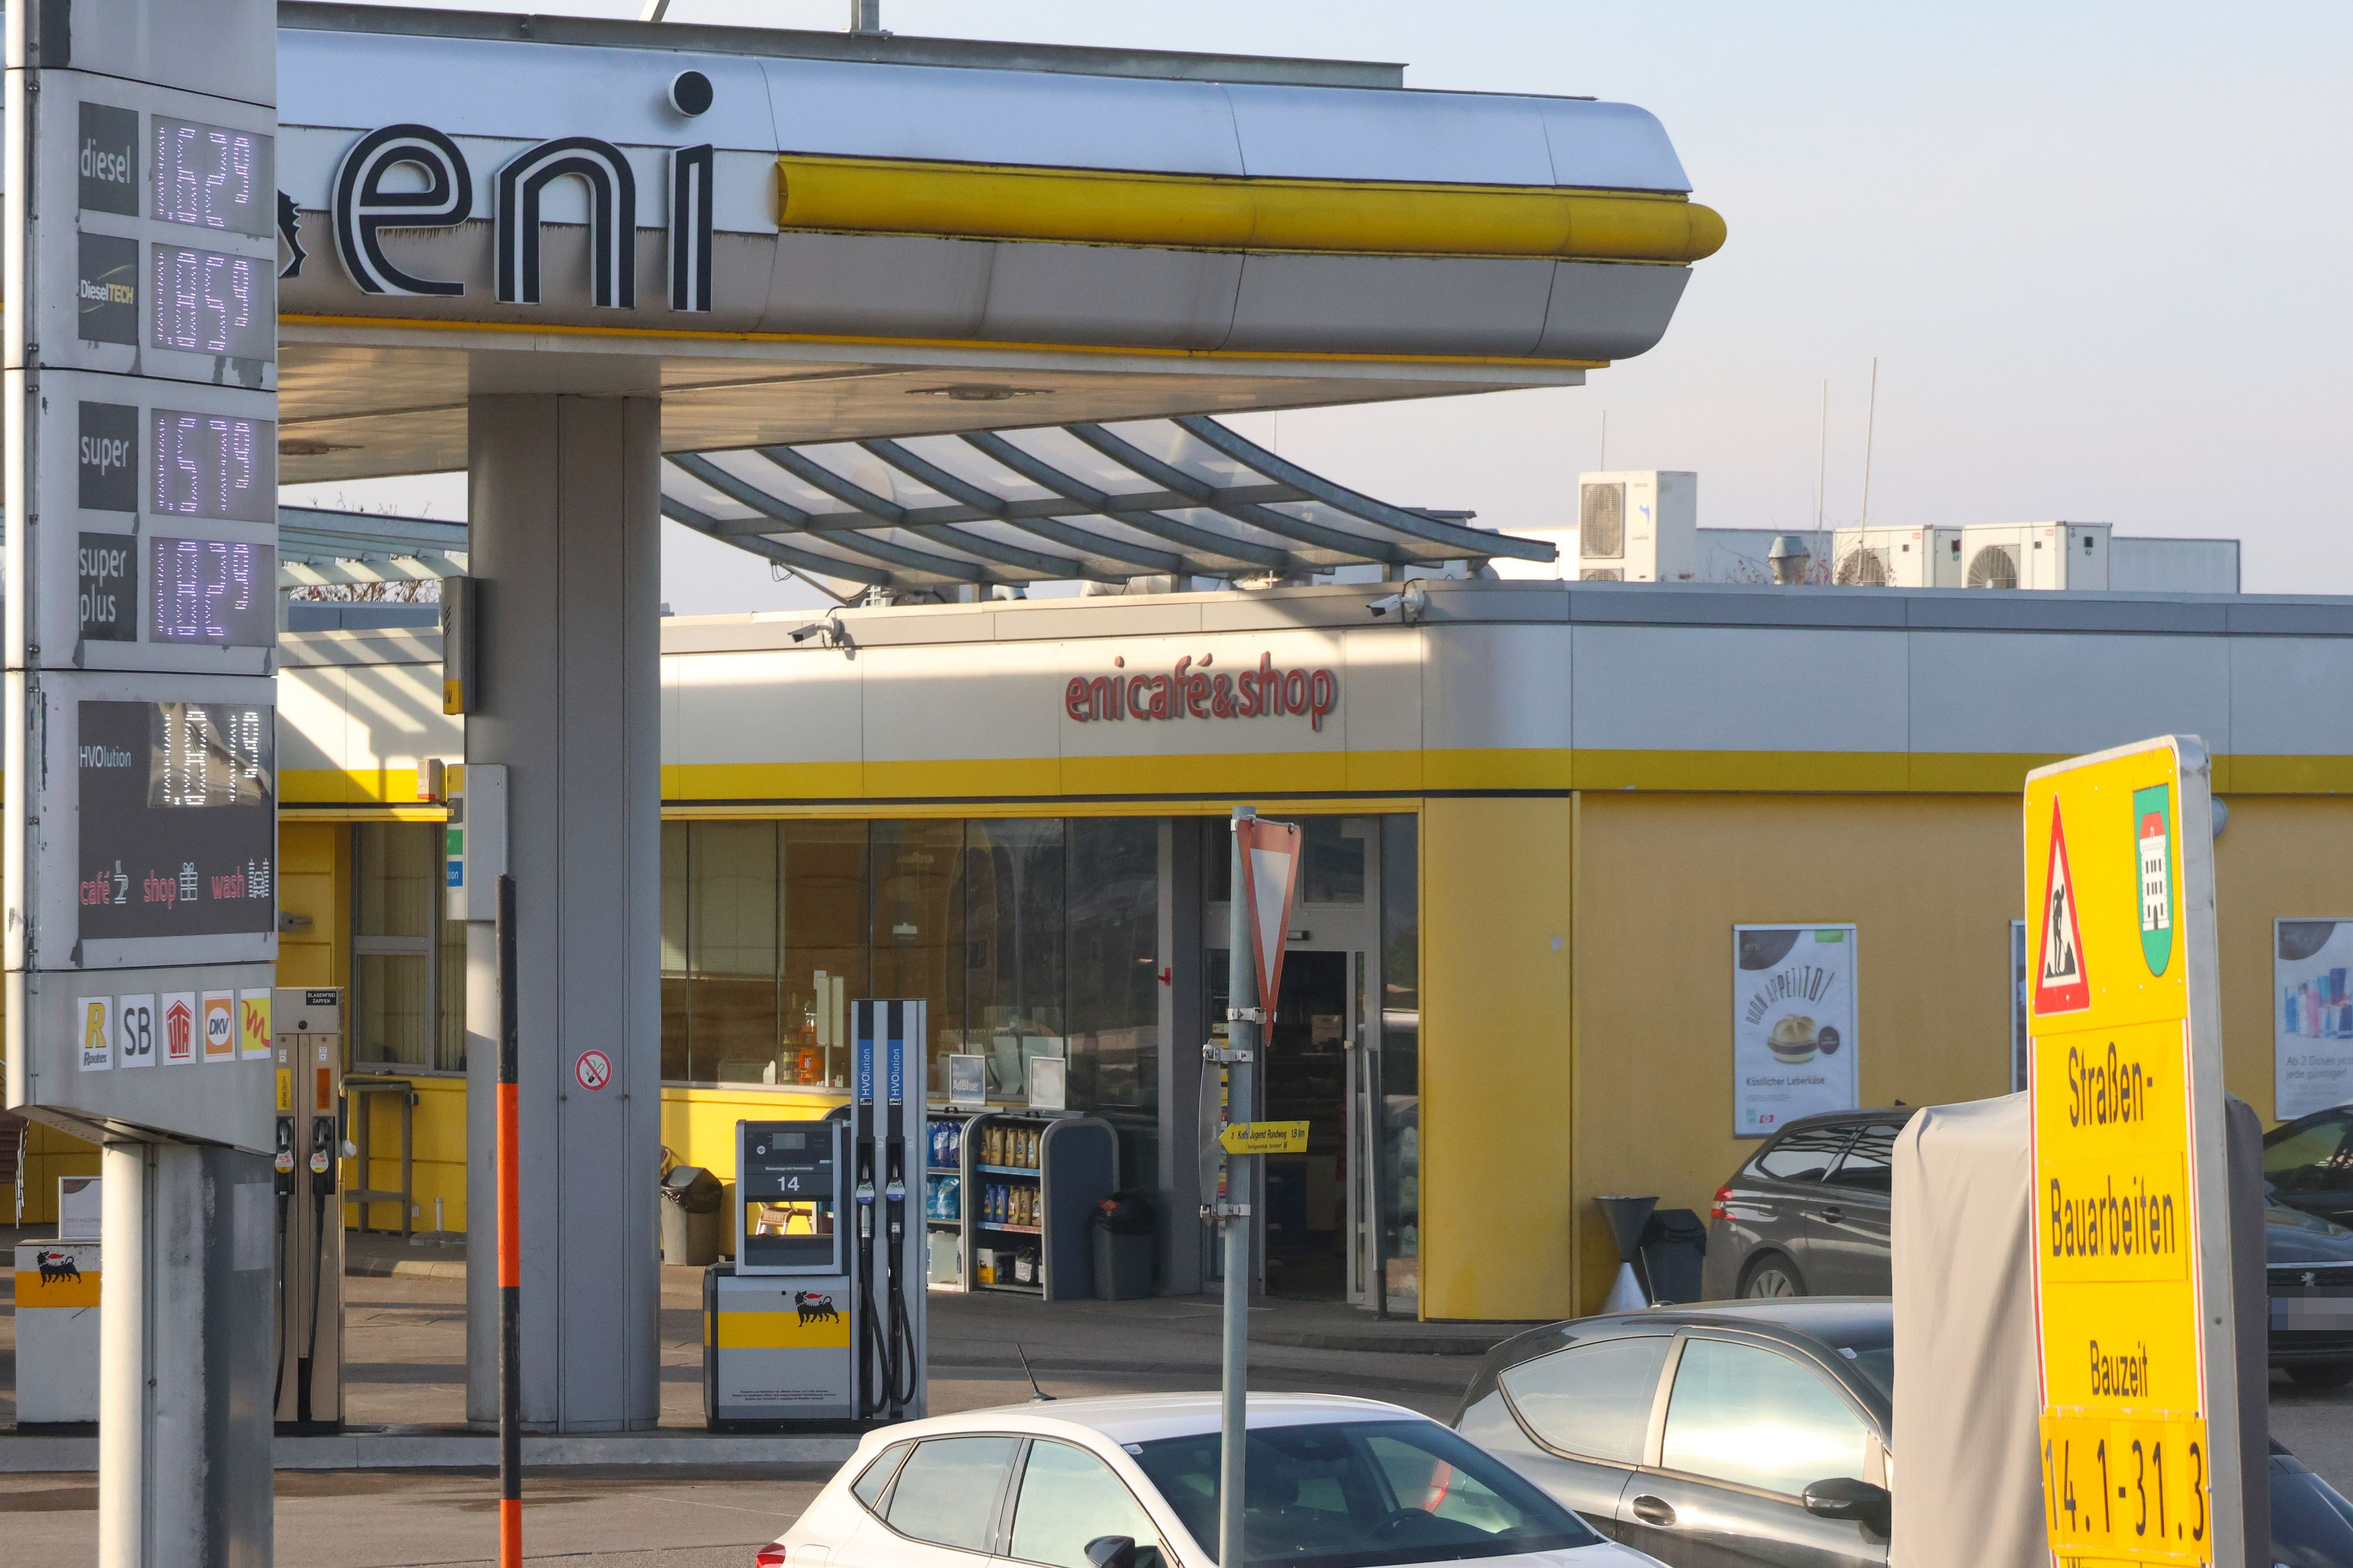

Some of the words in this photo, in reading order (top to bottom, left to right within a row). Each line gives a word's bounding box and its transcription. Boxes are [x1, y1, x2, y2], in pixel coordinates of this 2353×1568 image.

[81, 138, 131, 184] diesel
[332, 69, 714, 312] eni
[80, 279, 134, 305] DieselTECH
[81, 435, 129, 476] super
[79, 548, 127, 586] super
[80, 583, 116, 631] plus
[79, 745, 131, 768] HVOlution
[80, 870, 111, 905] café
[144, 870, 176, 909] shop
[211, 866, 245, 900] wash
[124, 1006, 152, 1056] SB
[209, 1017, 229, 1036] DKV
[861, 1048, 871, 1096] HVOlution
[891, 1049, 900, 1096] HVOlution
[952, 1079, 978, 1092] AdBlue
[1746, 1077, 1785, 1086] Köstlicher
[1787, 1076, 1825, 1085] Leberkäse
[2068, 1041, 2154, 1127] Straßen-
[1249, 1129, 1266, 1141] Jugend
[1267, 1128, 1287, 1140] Rundweg
[777, 1176, 800, 1192] 14
[2050, 1174, 2175, 1258] Bauarbeiten
[2090, 1339, 2148, 1399] Bauzeit
